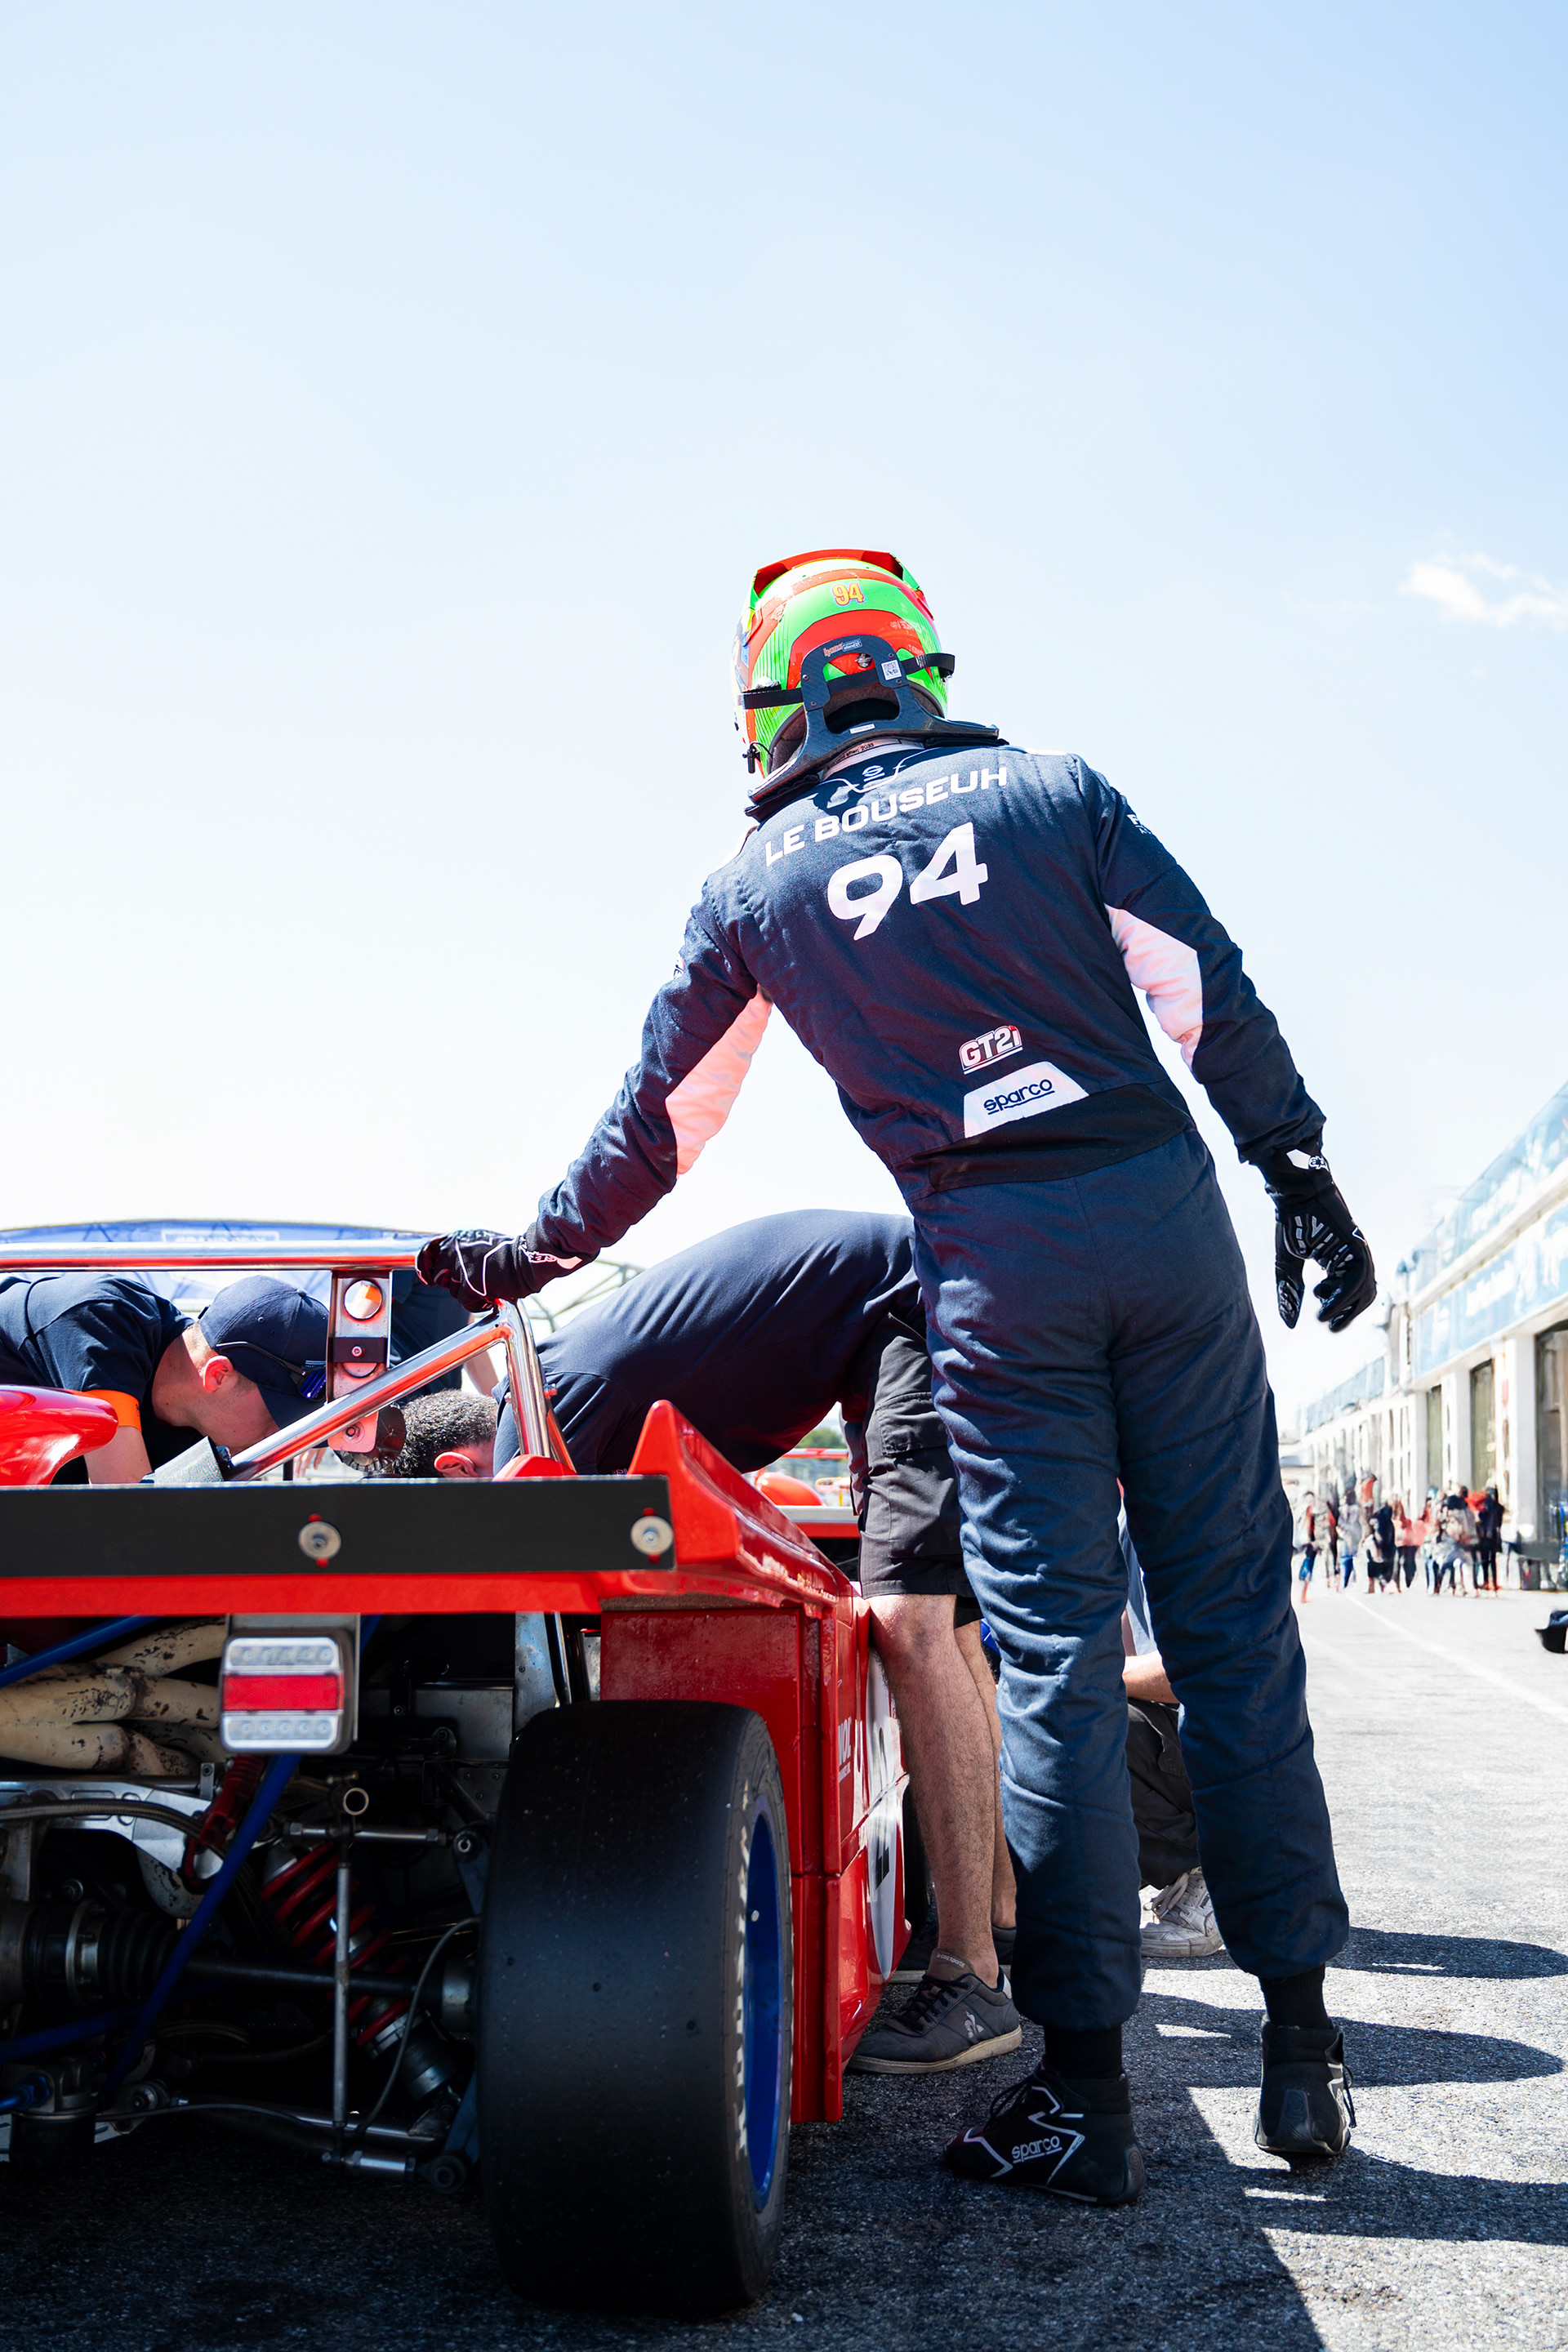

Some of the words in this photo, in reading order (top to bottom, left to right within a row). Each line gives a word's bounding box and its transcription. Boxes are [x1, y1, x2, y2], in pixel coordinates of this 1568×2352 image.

[831, 582, 864, 606] 94
[765, 824, 804, 867] LE
[815, 767, 1007, 842] BOUSEUH
[827, 822, 988, 940] 94
[960, 1026, 1022, 1071] GT2i
[983, 1079, 1054, 1114] sparco
[1012, 2136, 1061, 2163] sparco
